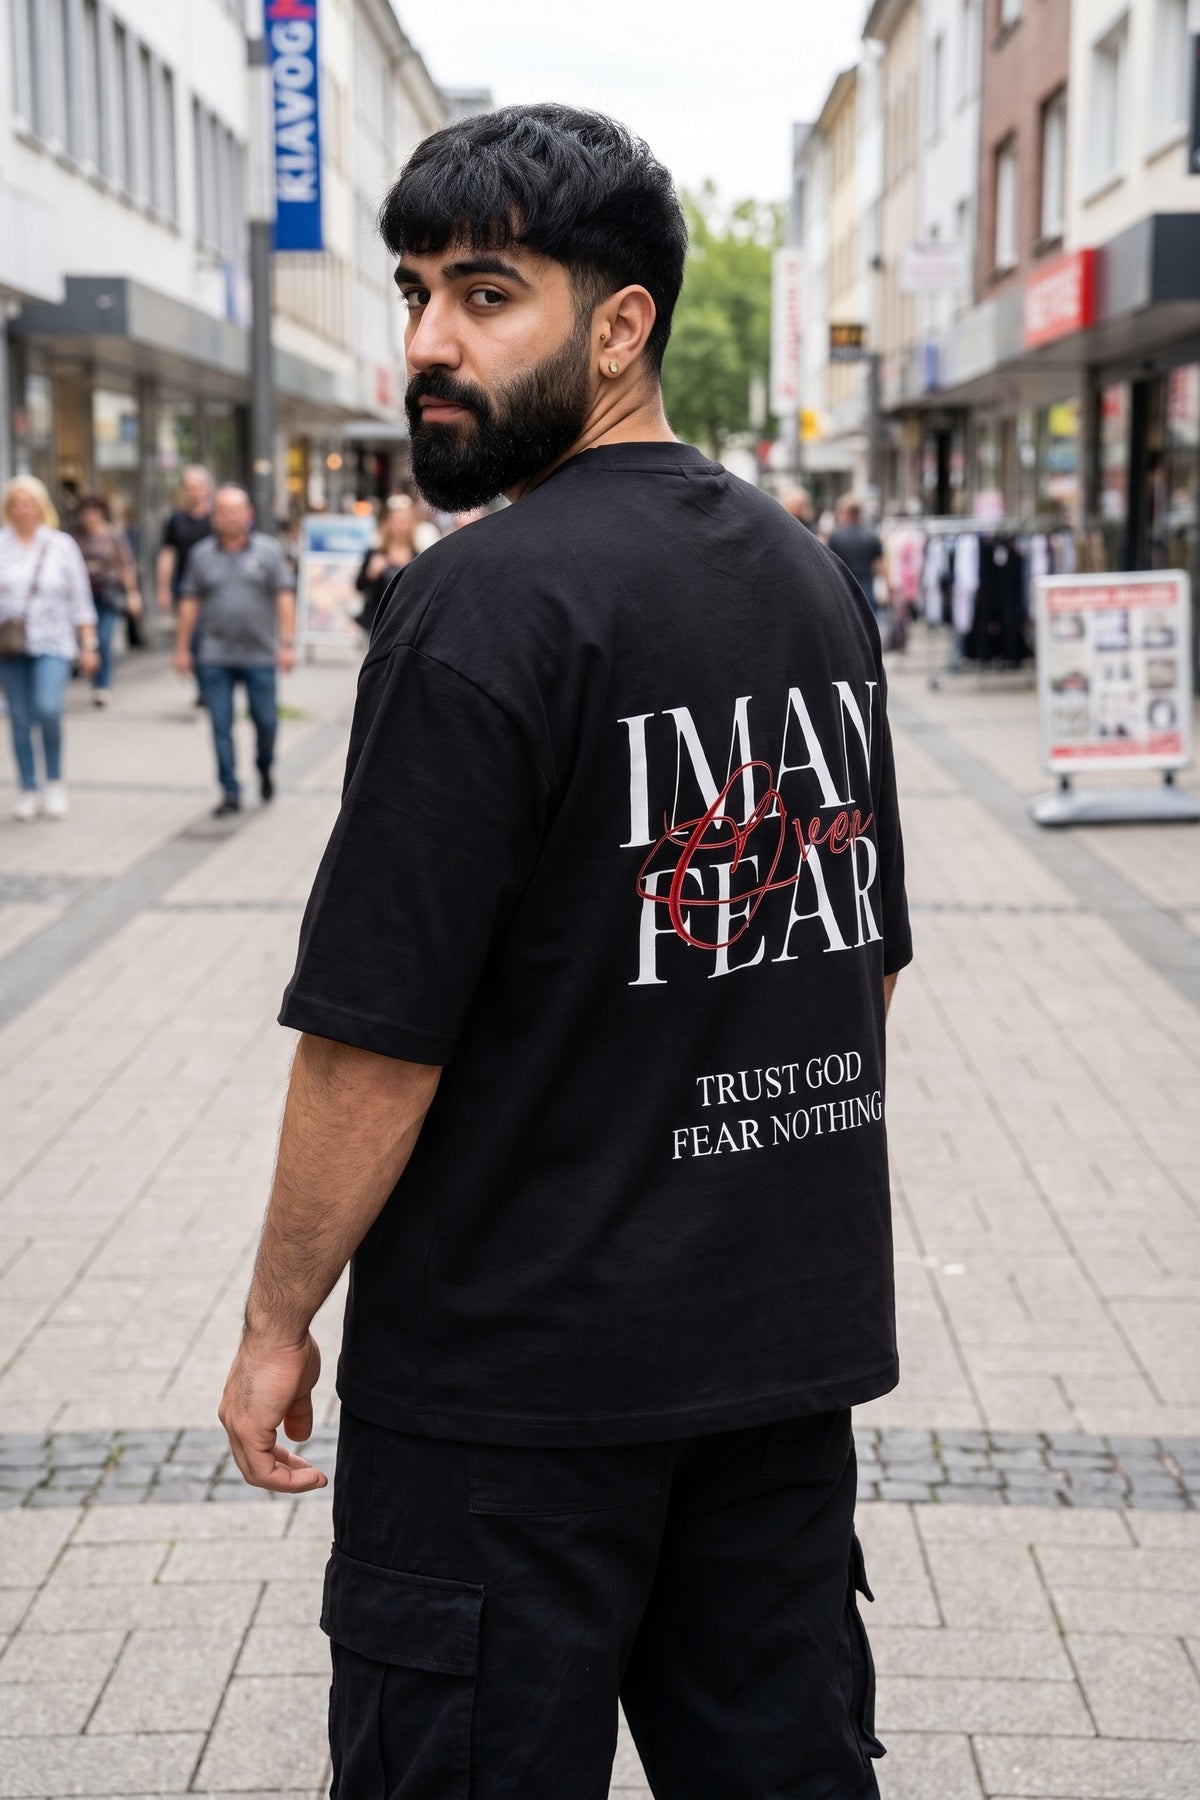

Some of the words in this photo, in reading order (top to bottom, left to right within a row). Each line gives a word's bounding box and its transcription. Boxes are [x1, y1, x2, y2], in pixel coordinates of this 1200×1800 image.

[617, 681, 877, 848] IMAN
[628, 836, 883, 985] FEAR
[671, 1118, 764, 1160] FEAR
[770, 1090, 883, 1146] NOTHING
[696, 1063, 799, 1107] TRUST
[805, 1051, 862, 1089] GOD
